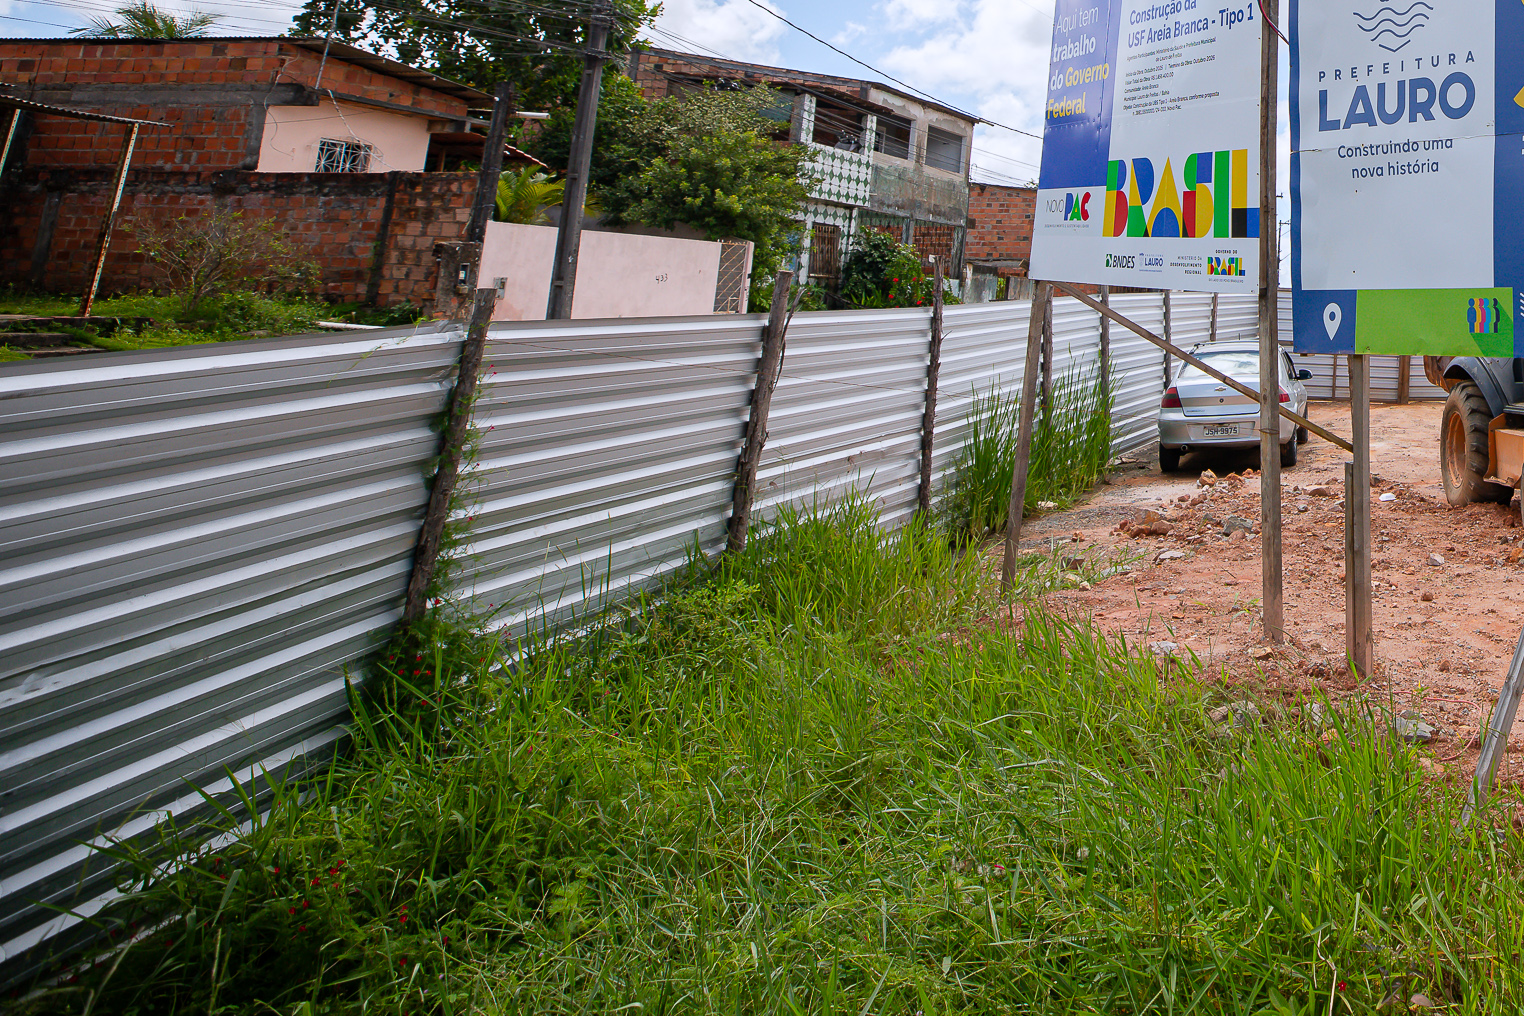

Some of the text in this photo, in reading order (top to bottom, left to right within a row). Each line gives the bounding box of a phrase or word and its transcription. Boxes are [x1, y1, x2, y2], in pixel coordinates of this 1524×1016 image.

[1055, 6, 1099, 37] Aqui tem
[1128, 29, 1146, 48] USF
[1146, 24, 1172, 44] Areia
[1173, 17, 1209, 38] Branca
[1218, 7, 1244, 30] Tipo
[1247, 2, 1254, 21] 1
[1053, 34, 1096, 63] trabalho
[1050, 62, 1110, 91] do Governo
[1318, 50, 1475, 82] PREFEITURA
[1047, 91, 1086, 120] Federal
[1318, 71, 1475, 132] LAURO
[1337, 138, 1453, 159] Construindo uma
[1352, 158, 1439, 179] nova história
[1046, 192, 1091, 221] NOVO PAC
[1102, 149, 1260, 238] BRASIL
[1112, 254, 1136, 269] BNDES
[1145, 257, 1164, 267] LAURO
[1207, 256, 1246, 276] BRASIL
